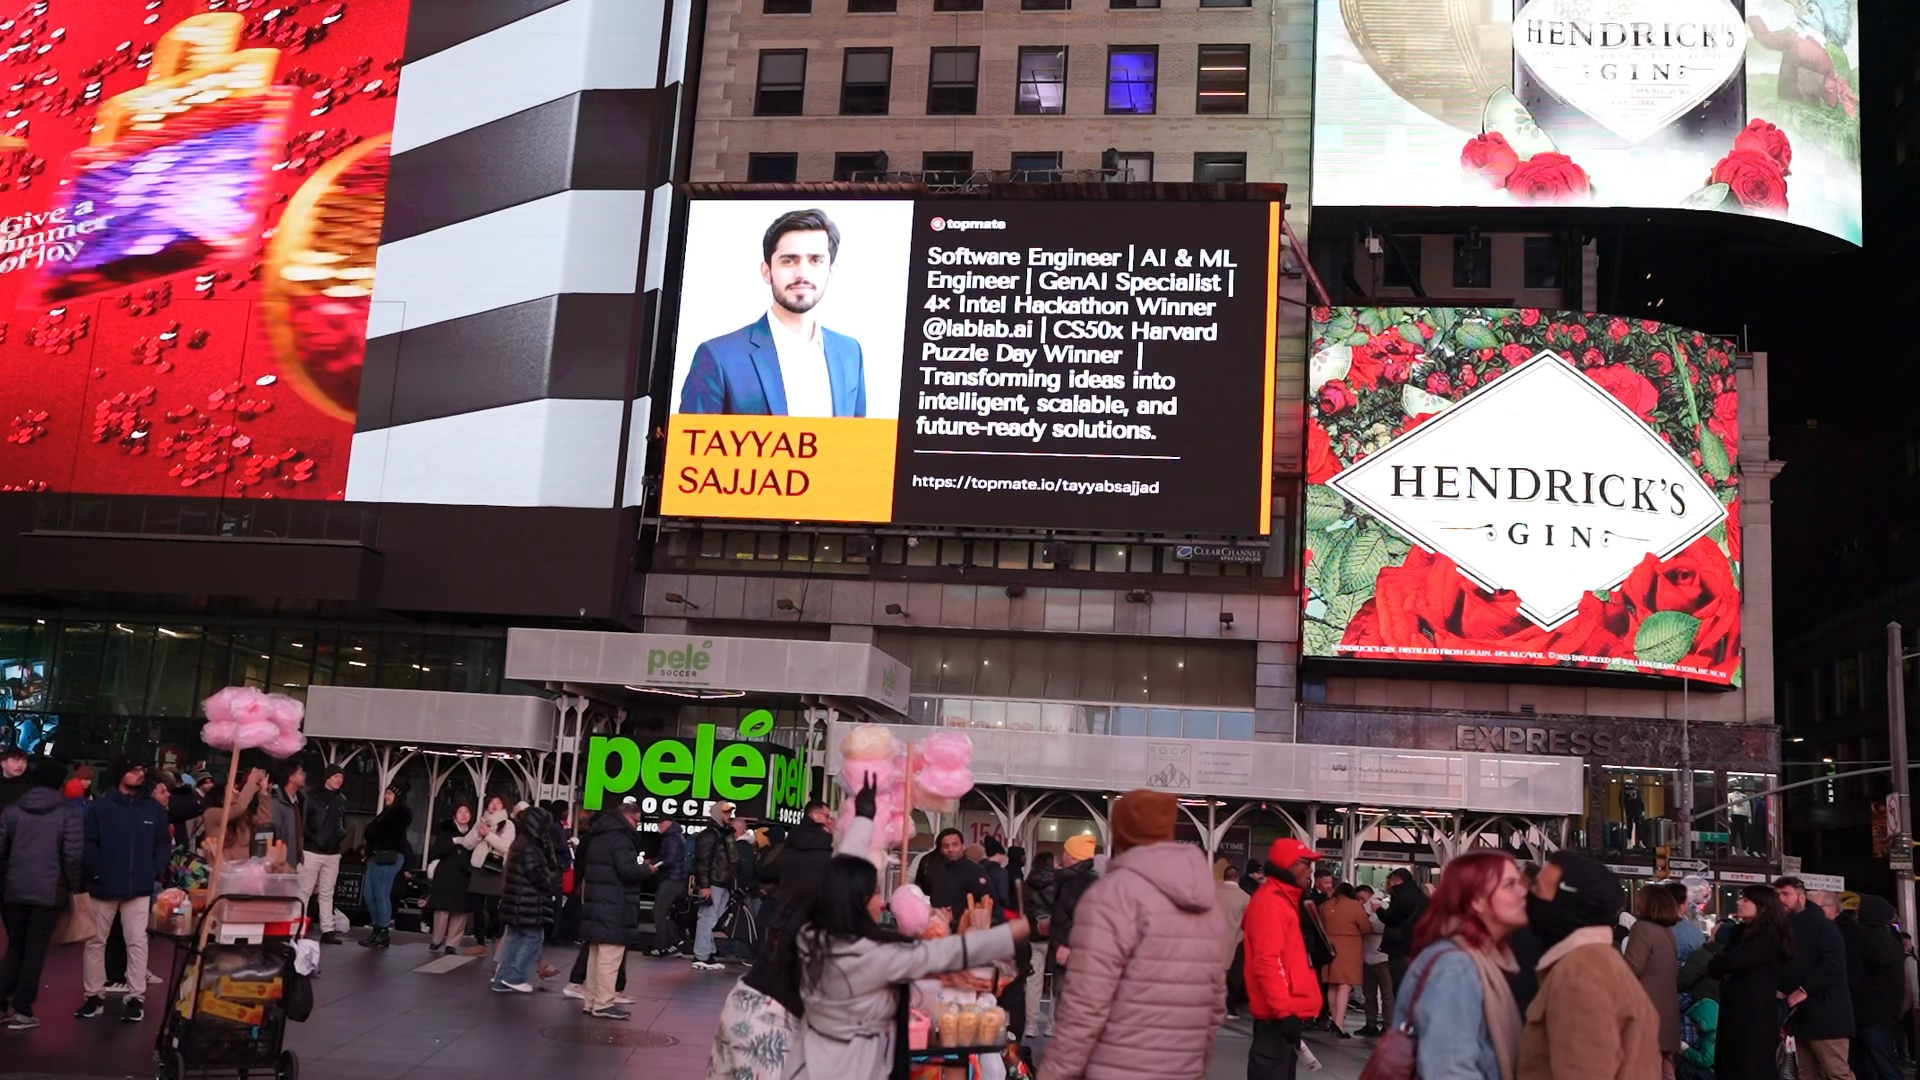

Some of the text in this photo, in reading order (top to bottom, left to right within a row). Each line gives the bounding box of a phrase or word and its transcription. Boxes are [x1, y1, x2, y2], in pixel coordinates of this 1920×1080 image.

[1601, 62, 1670, 81] GIN
[0, 200, 95, 239] Give a
[946, 219, 1007, 232] topmate
[927, 246, 1021, 266] Software
[1027, 247, 1122, 272] Engineer
[1140, 248, 1167, 267] AI
[1174, 248, 1193, 268] &
[1199, 249, 1238, 268] ML
[927, 270, 1021, 295] Engineer
[1038, 271, 1108, 291] GenAI
[1115, 271, 1222, 297] Specialist
[959, 294, 1007, 314] Intel
[1014, 295, 1129, 316] Hackathon
[1135, 296, 1217, 317] Winner
[922, 316, 1034, 341] @lablab.ai
[1052, 319, 1124, 340] CS50x
[1131, 320, 1218, 342] Harvard
[921, 342, 990, 363] Puzzle
[995, 343, 1038, 369] Day
[1042, 344, 1124, 365] Winner
[919, 366, 1176, 394] Transforming ideas into
[918, 390, 1178, 418] intelligent, scalable, and
[915, 415, 1157, 443] future-ready solutions.
[683, 429, 818, 459] TAYYAB
[678, 466, 810, 497] SAJJAD
[912, 474, 1160, 497] https://topmate.io/tayyabsajjad
[1389, 464, 1688, 518] HENDRICK'S
[1507, 522, 1593, 548] GIN
[1398, 647, 1439, 655] DISTILLED
[660, 669, 697, 678] SOCCER
[1456, 724, 1613, 756] EXPRESS
[583, 709, 774, 811] pelé
[778, 807, 805, 825] SOCCE
[970, 822, 1014, 848] 156
